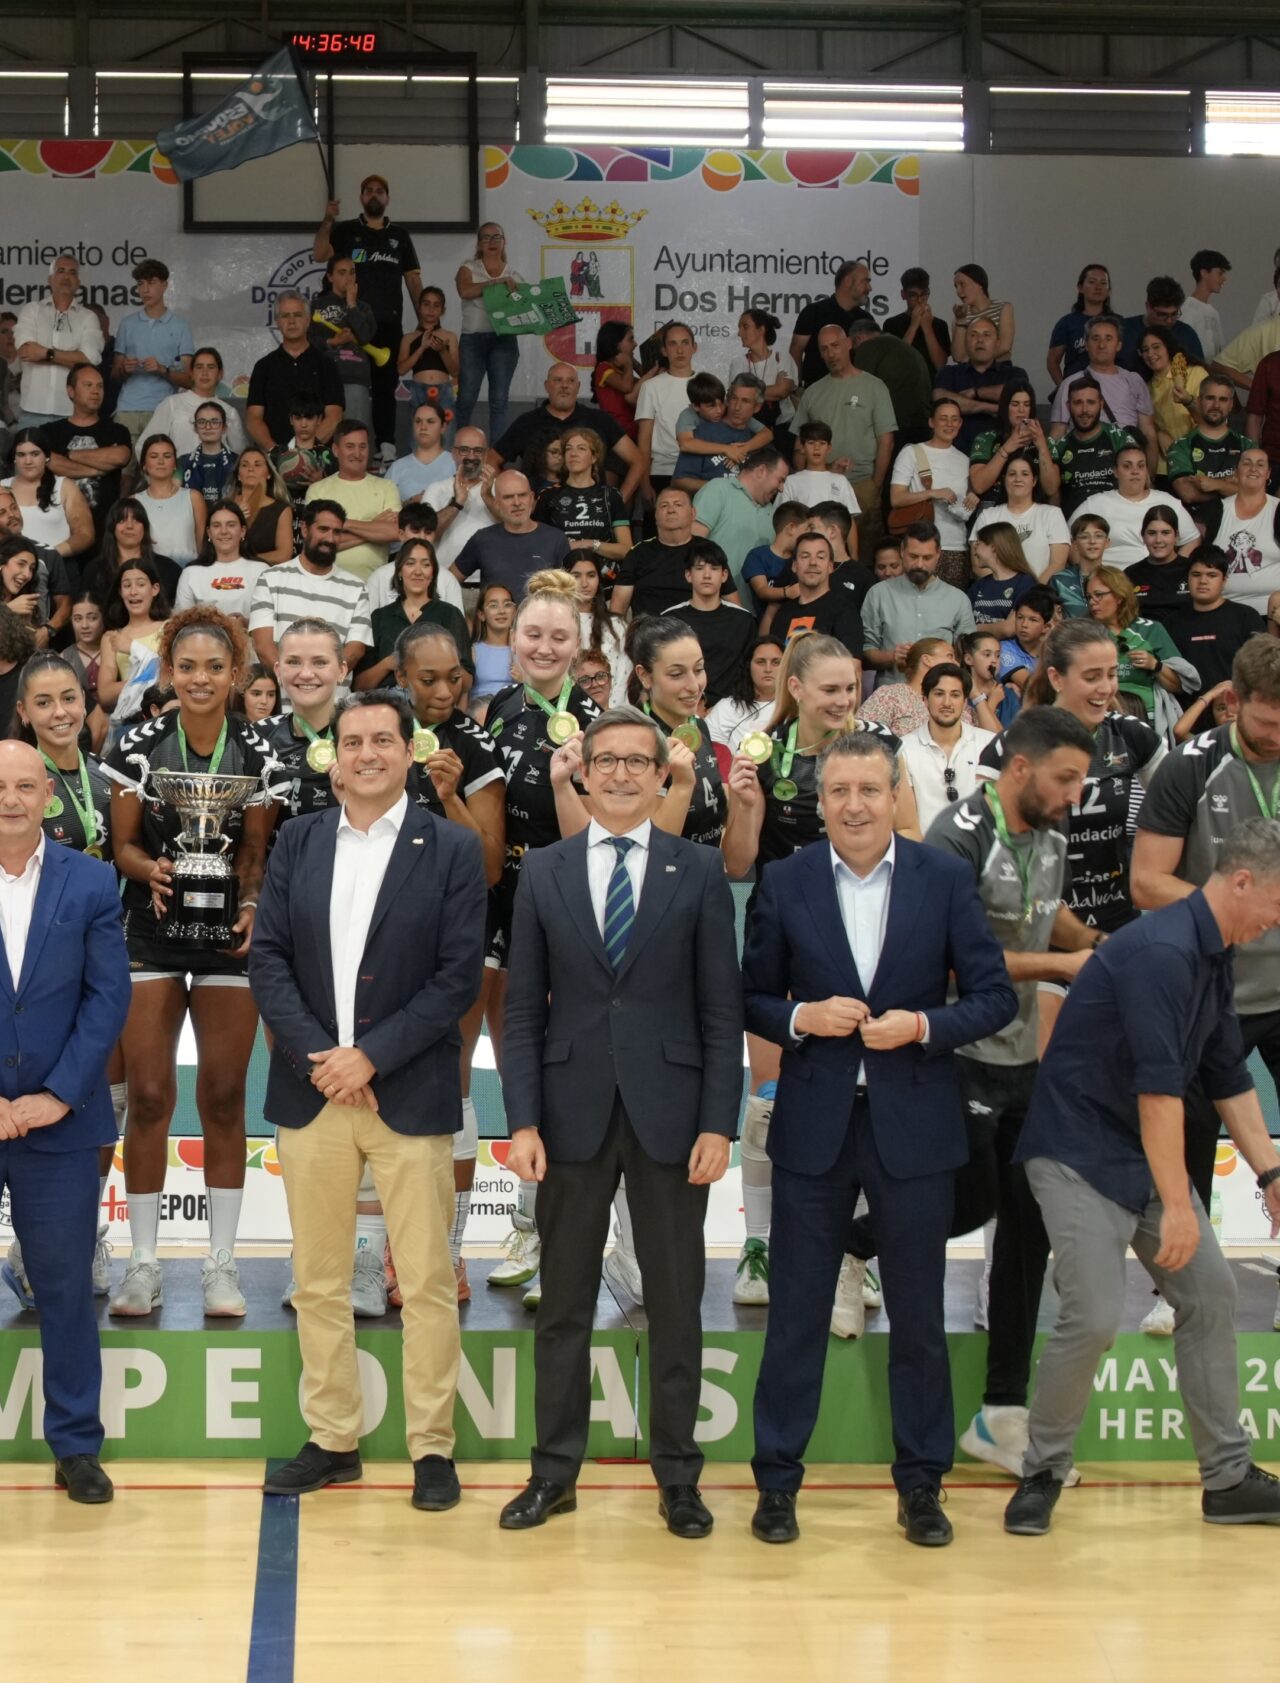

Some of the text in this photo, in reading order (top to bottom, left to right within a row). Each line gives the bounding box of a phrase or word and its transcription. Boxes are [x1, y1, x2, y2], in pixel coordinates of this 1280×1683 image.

[293, 34, 375, 51] 14:36:48
[112, 240, 147, 267] de
[654, 245, 845, 278] Ayuntamiento
[655, 284, 890, 316] Dos Herms
[654, 320, 730, 338] Dortes
[1074, 468, 1114, 479] Fundació
[576, 503, 590, 520] 2
[564, 520, 605, 528] Fundación
[472, 1177, 514, 1193] iento
[1093, 1358, 1178, 1392] MAY
